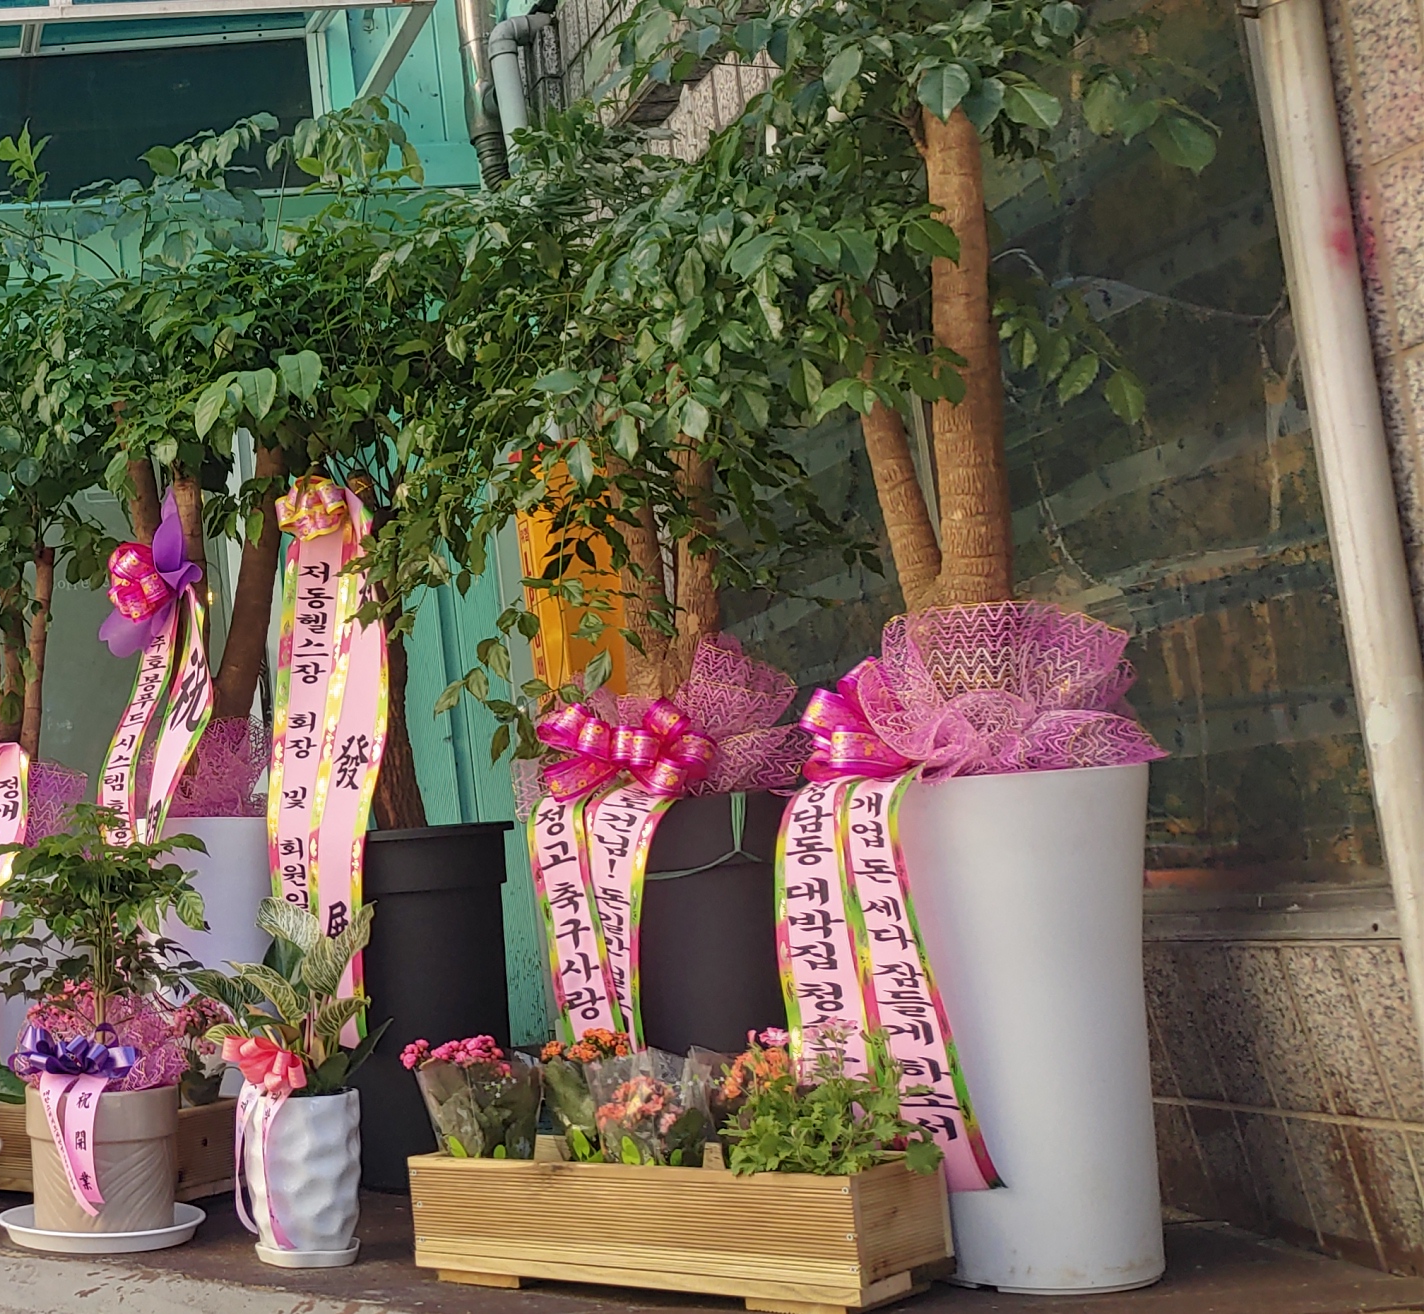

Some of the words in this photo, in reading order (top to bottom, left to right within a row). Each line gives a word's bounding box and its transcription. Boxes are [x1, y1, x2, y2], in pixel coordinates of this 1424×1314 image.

[290, 560, 335, 686] 저동헬스장
[285, 710, 318, 760] 회장
[280, 786, 308, 811] 및
[850, 791, 884, 849] 개업
[854, 858, 898, 884] 돈
[786, 876, 845, 971] 대박집
